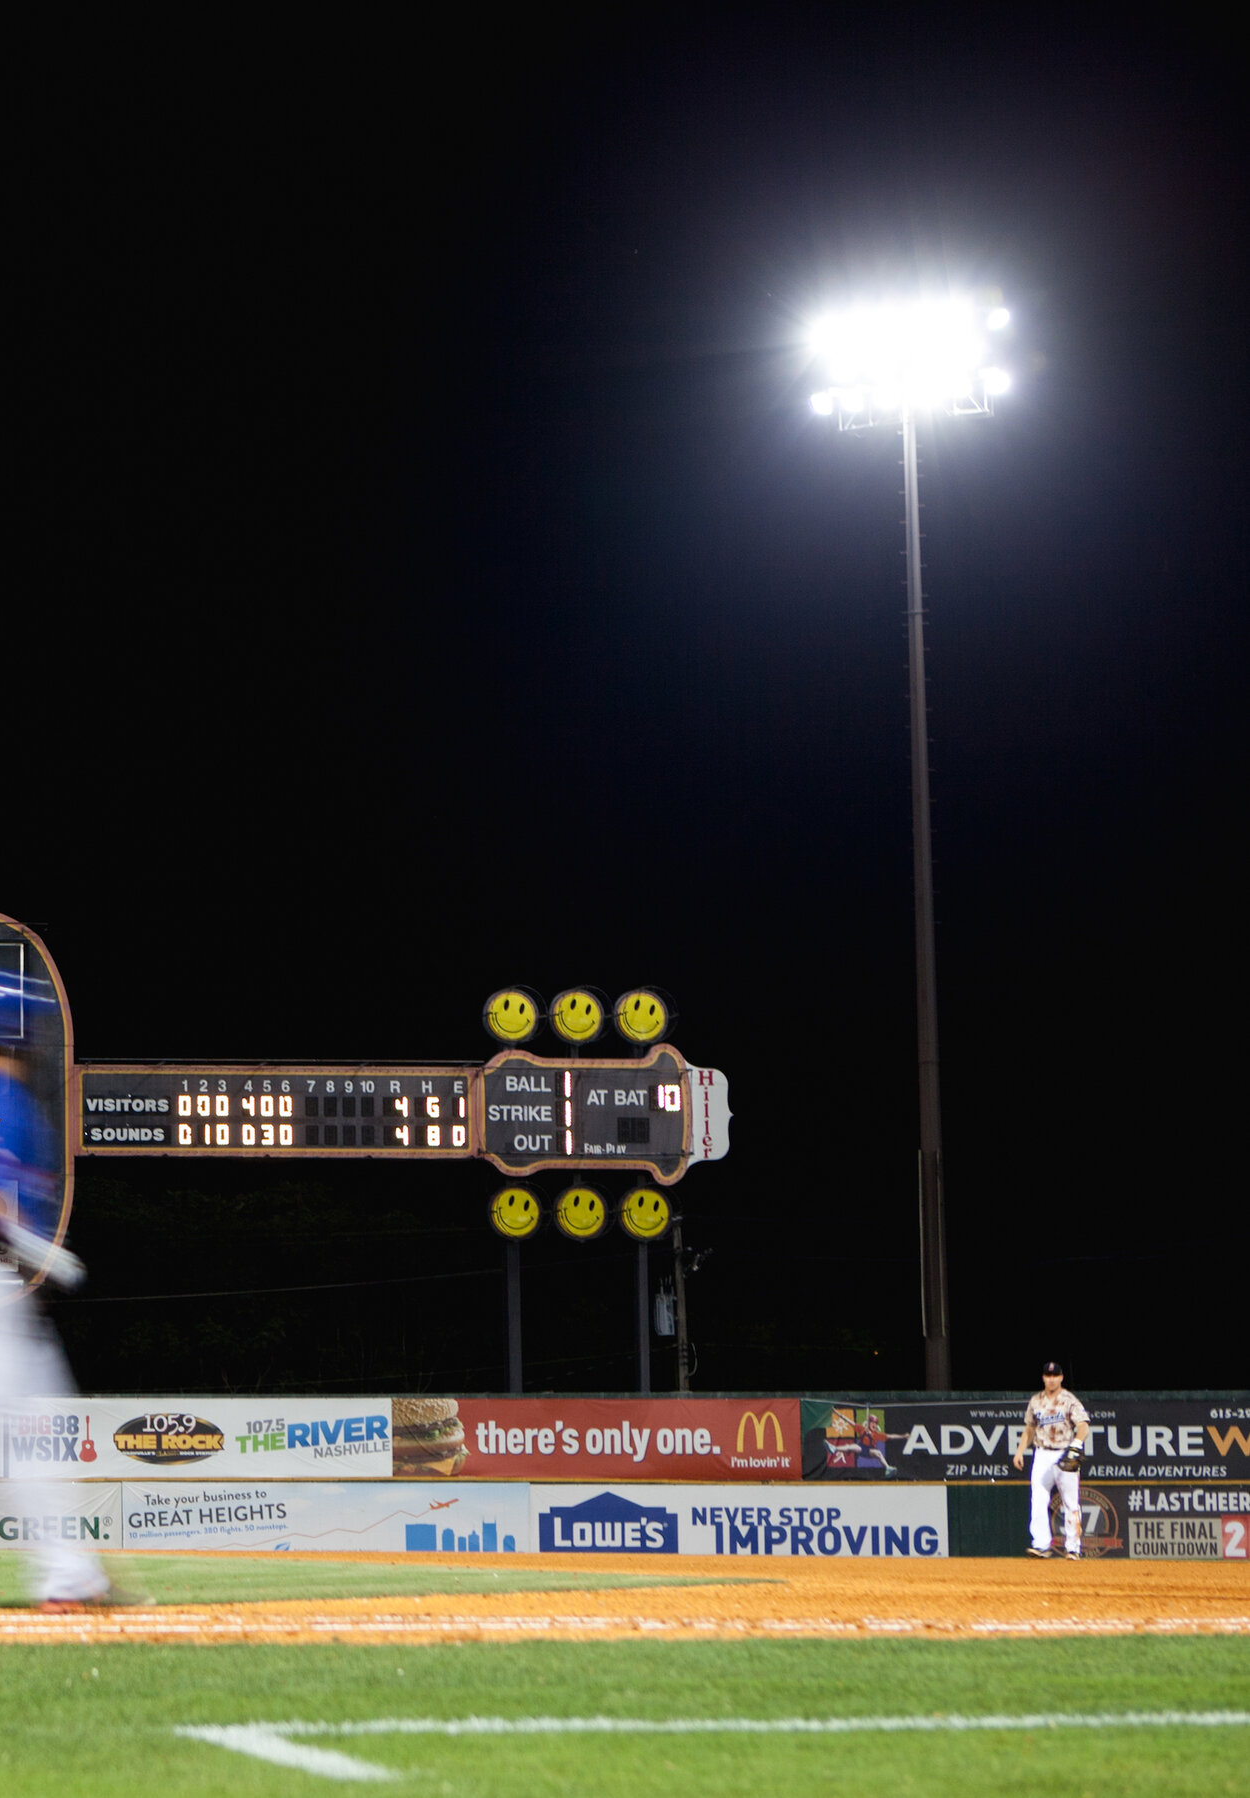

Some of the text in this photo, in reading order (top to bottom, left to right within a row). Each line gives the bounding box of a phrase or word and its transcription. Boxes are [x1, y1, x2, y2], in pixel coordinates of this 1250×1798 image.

[181, 1080, 463, 1093] 1 2 3 4 5 6 7 8 9 10 R H E
[506, 1076, 551, 1092] BALL
[86, 1098, 169, 1112] VISITORS
[587, 1090, 608, 1105] AT
[614, 1090, 647, 1105] BAT
[488, 1105, 552, 1122] STRIKE
[90, 1127, 165, 1142] SOUNDS
[513, 1135, 552, 1151] OUT
[142, 1413, 197, 1435] 105.9
[246, 1418, 285, 1434] 107.5
[287, 1414, 388, 1449] RIVER
[12, 1436, 79, 1462] WSIX
[113, 1434, 224, 1451] THE ROCK
[236, 1434, 285, 1454] THE
[313, 1440, 390, 1459] NASHVILLE
[476, 1421, 720, 1462] there's only one.
[731, 1456, 789, 1468] i'm lovin' it
[946, 1464, 1227, 1477] ZIP LINES AERIAL ADVENTURES
[144, 1490, 267, 1508] Take your business to
[128, 1503, 286, 1529] GREAT HEIGHTS
[692, 1507, 841, 1527] NEVER STOP
[553, 1516, 664, 1548] LOWE'S
[716, 1525, 939, 1556] IMPROVING
[1133, 1521, 1247, 1557] THE FINAL 2
[1133, 1542, 1218, 1556] COUNTDOWN
